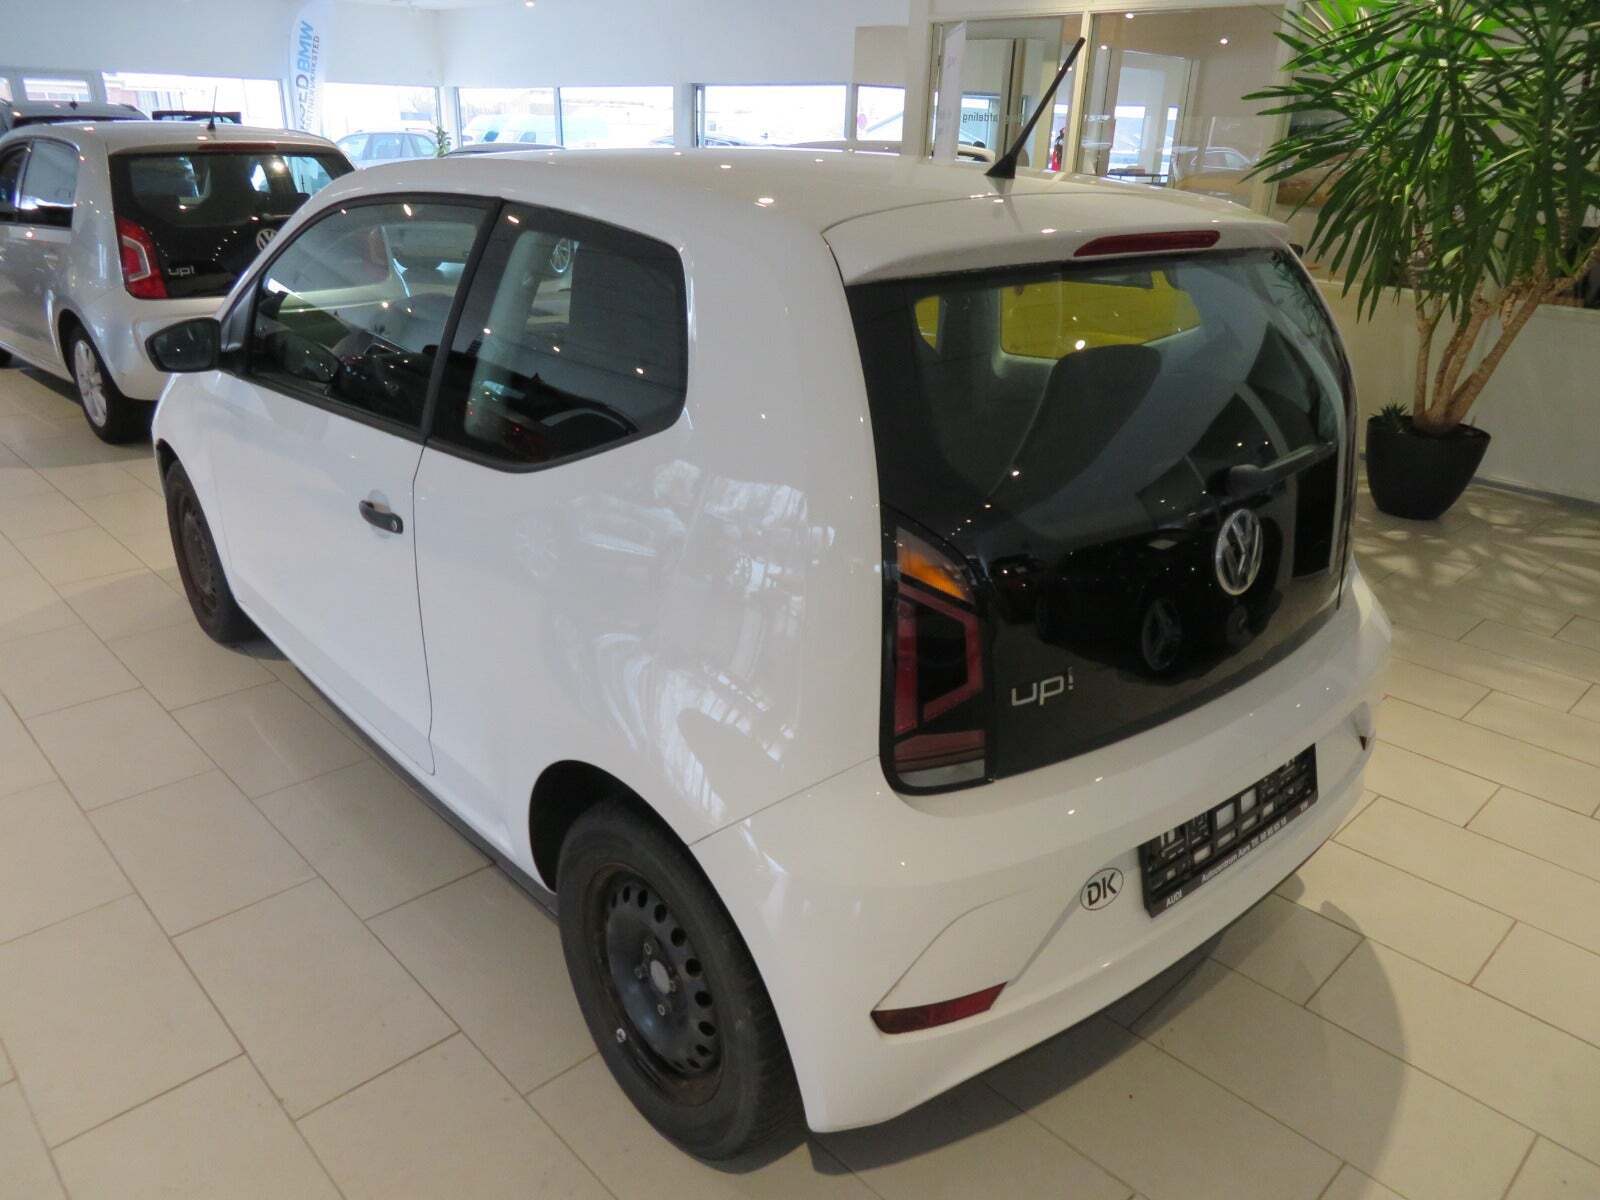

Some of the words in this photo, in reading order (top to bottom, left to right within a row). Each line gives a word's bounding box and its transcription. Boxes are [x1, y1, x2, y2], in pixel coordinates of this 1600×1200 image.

[297, 20, 313, 72] BMW
[1011, 667, 1074, 706] up!
[1087, 872, 1117, 906] DK
[1166, 888, 1182, 907] AUDI
